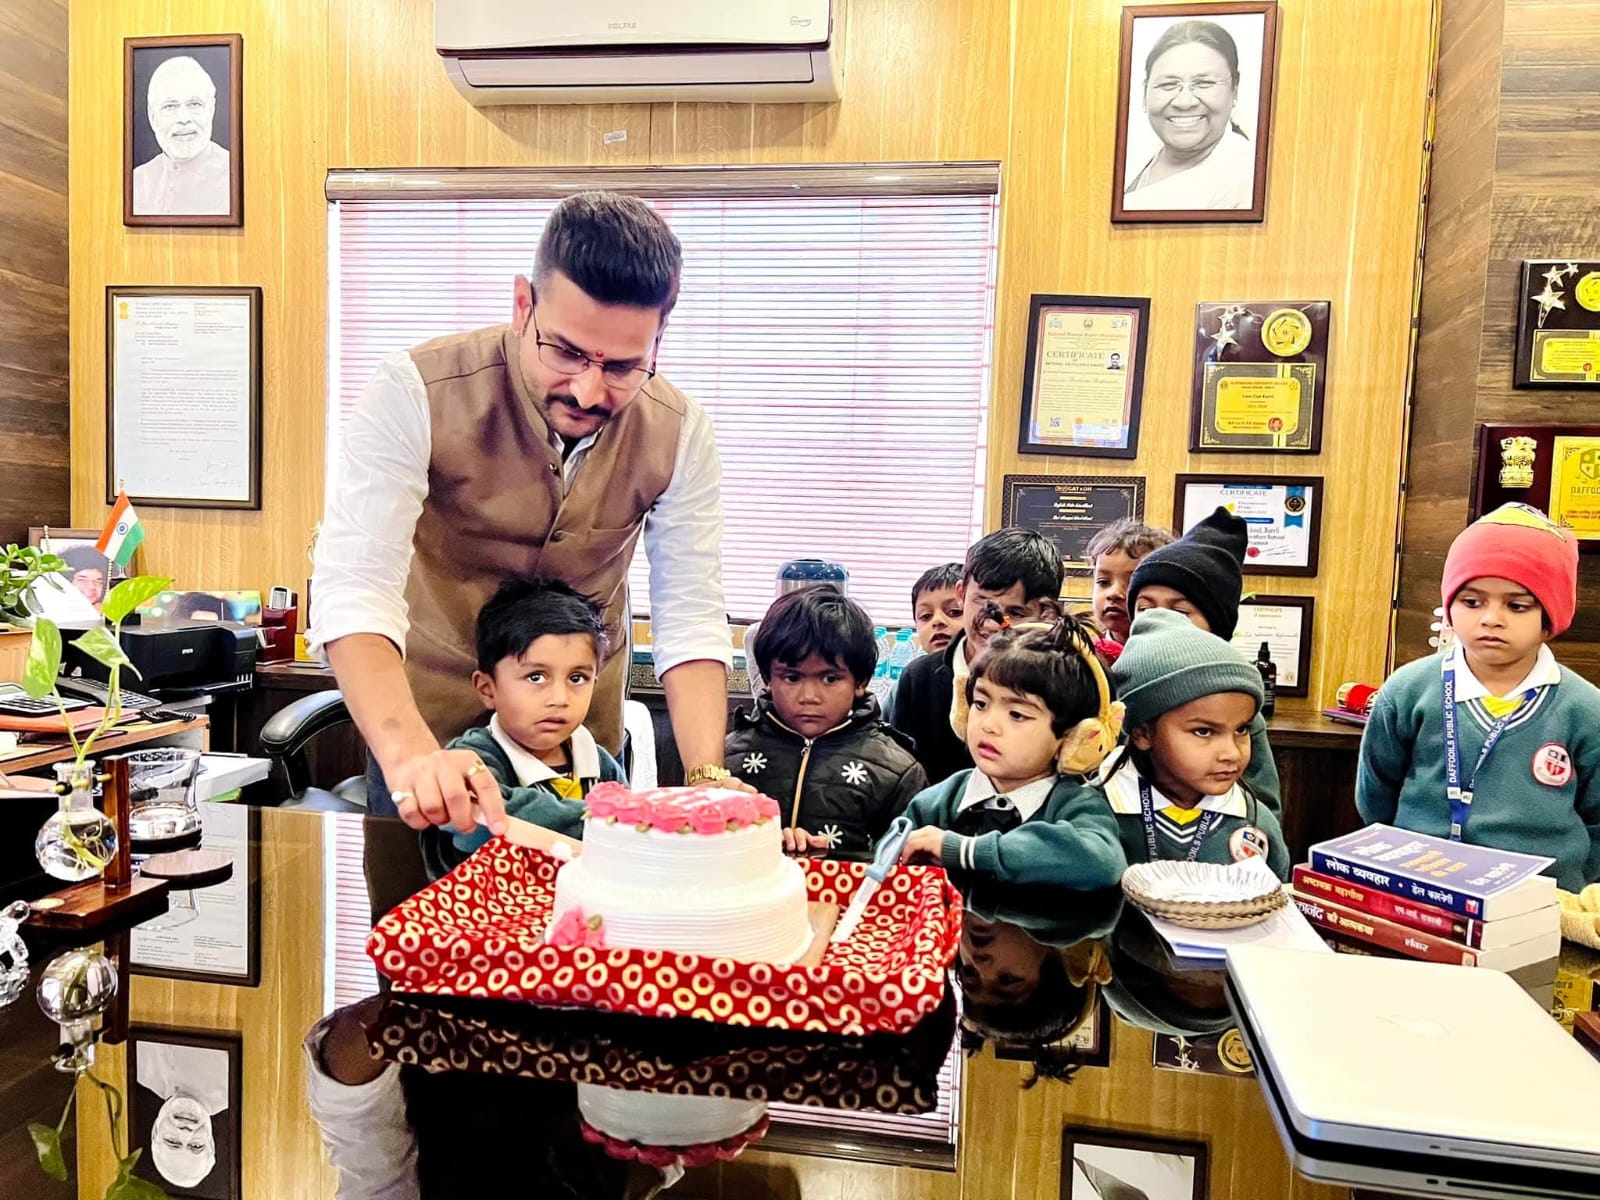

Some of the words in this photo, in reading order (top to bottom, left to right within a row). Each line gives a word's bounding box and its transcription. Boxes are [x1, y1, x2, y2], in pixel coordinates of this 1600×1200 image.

[608, 22, 637, 30] VOLTAS
[1046, 351, 1105, 360] CERTIFICATE
[1445, 679, 1453, 710] SCHOOL
[1446, 710, 1454, 738] PUBLIC
[1484, 721, 1504, 747] PUBLIC
[1447, 740, 1457, 783] DAFFODILS
[1142, 787, 1152, 822] SCHOOL
[1146, 823, 1158, 856] PUBLIC
[1186, 839, 1201, 862] ODILS
[1195, 811, 1211, 840] PUBLIC
[1325, 857, 1350, 874] लोक
[1352, 867, 1390, 887] व्यवहार
[1411, 882, 1425, 896] डेल
